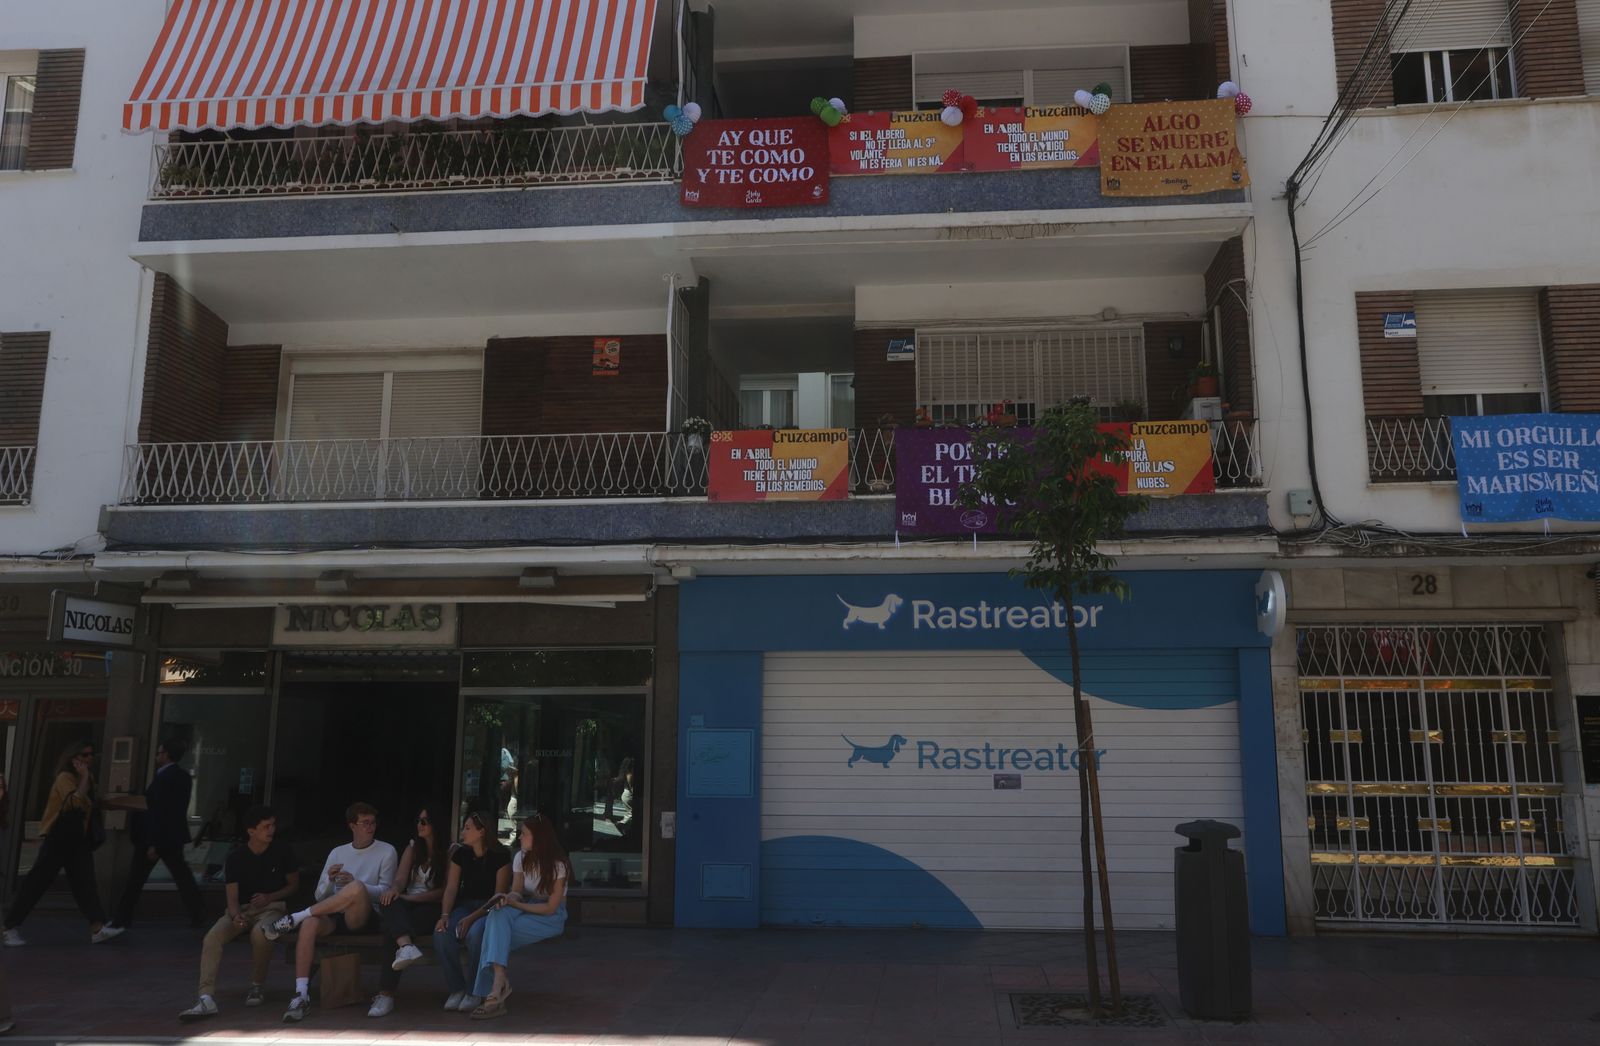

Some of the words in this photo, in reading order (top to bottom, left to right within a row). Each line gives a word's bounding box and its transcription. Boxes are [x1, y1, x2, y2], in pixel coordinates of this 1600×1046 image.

[890, 111, 942, 123] Cruzcam
[1024, 106, 1094, 118] Cruzcamp
[984, 124, 994, 134] EN
[997, 123, 1024, 134] ABRIL
[1143, 113, 1200, 132] ALGO
[717, 130, 745, 147] AY
[748, 128, 793, 147] QUE
[849, 131, 858, 141] SI
[876, 129, 905, 140] ALBERO
[1008, 133, 1027, 143] TODO
[1030, 133, 1039, 142] EL
[1041, 130, 1069, 142] MUNDO
[865, 140, 876, 150] NO
[878, 139, 887, 149] TE
[889, 138, 912, 149] LLEGA
[914, 137, 923, 148] AL
[997, 142, 1018, 153] TIENE
[1020, 143, 1031, 152] UN
[1033, 141, 1064, 152] AMIGO
[1118, 137, 1144, 153] SE
[1150, 131, 1229, 151] MUERE
[706, 149, 735, 166] TE
[740, 148, 805, 166] COMO
[1010, 152, 1020, 162] EN
[1022, 152, 1036, 161] LOS
[1037, 150, 1080, 161] REMEDIOS.
[1112, 154, 1140, 171] EN
[1147, 154, 1174, 170] EL
[860, 160, 868, 169] NI
[869, 159, 879, 168] ES
[881, 158, 903, 168] FERIA
[907, 158, 916, 167] NI
[917, 157, 927, 167] ES
[696, 168, 711, 184] Y
[715, 168, 744, 184] TE
[749, 167, 814, 184] COMO
[1130, 422, 1208, 436] Cruzcampo
[773, 431, 847, 443] Cruzcampo
[1460, 429, 1492, 449] MI
[731, 449, 741, 459] EN
[744, 448, 772, 459] ABRIL
[1496, 450, 1529, 471] ES
[1533, 449, 1580, 470] SER
[755, 460, 775, 470] TODO
[777, 459, 787, 470] EL
[789, 458, 817, 469] MUNDO
[1134, 462, 1151, 473] POR
[1153, 461, 1175, 473] LAS
[743, 470, 765, 481] TIENE
[767, 470, 777, 480] UN
[780, 469, 812, 480] AMIGO
[920, 465, 950, 484] EL
[756, 482, 765, 492] EN
[767, 481, 782, 491] LOS
[784, 480, 827, 491] REMEDIOS.
[1137, 477, 1169, 489] NUBES.
[1411, 574, 1437, 595] 28
[284, 604, 442, 632] NICOLAS
[911, 600, 1103, 629] Rastreator
[65, 610, 133, 635] NICOLAS
[63, 659, 82, 675] 30
